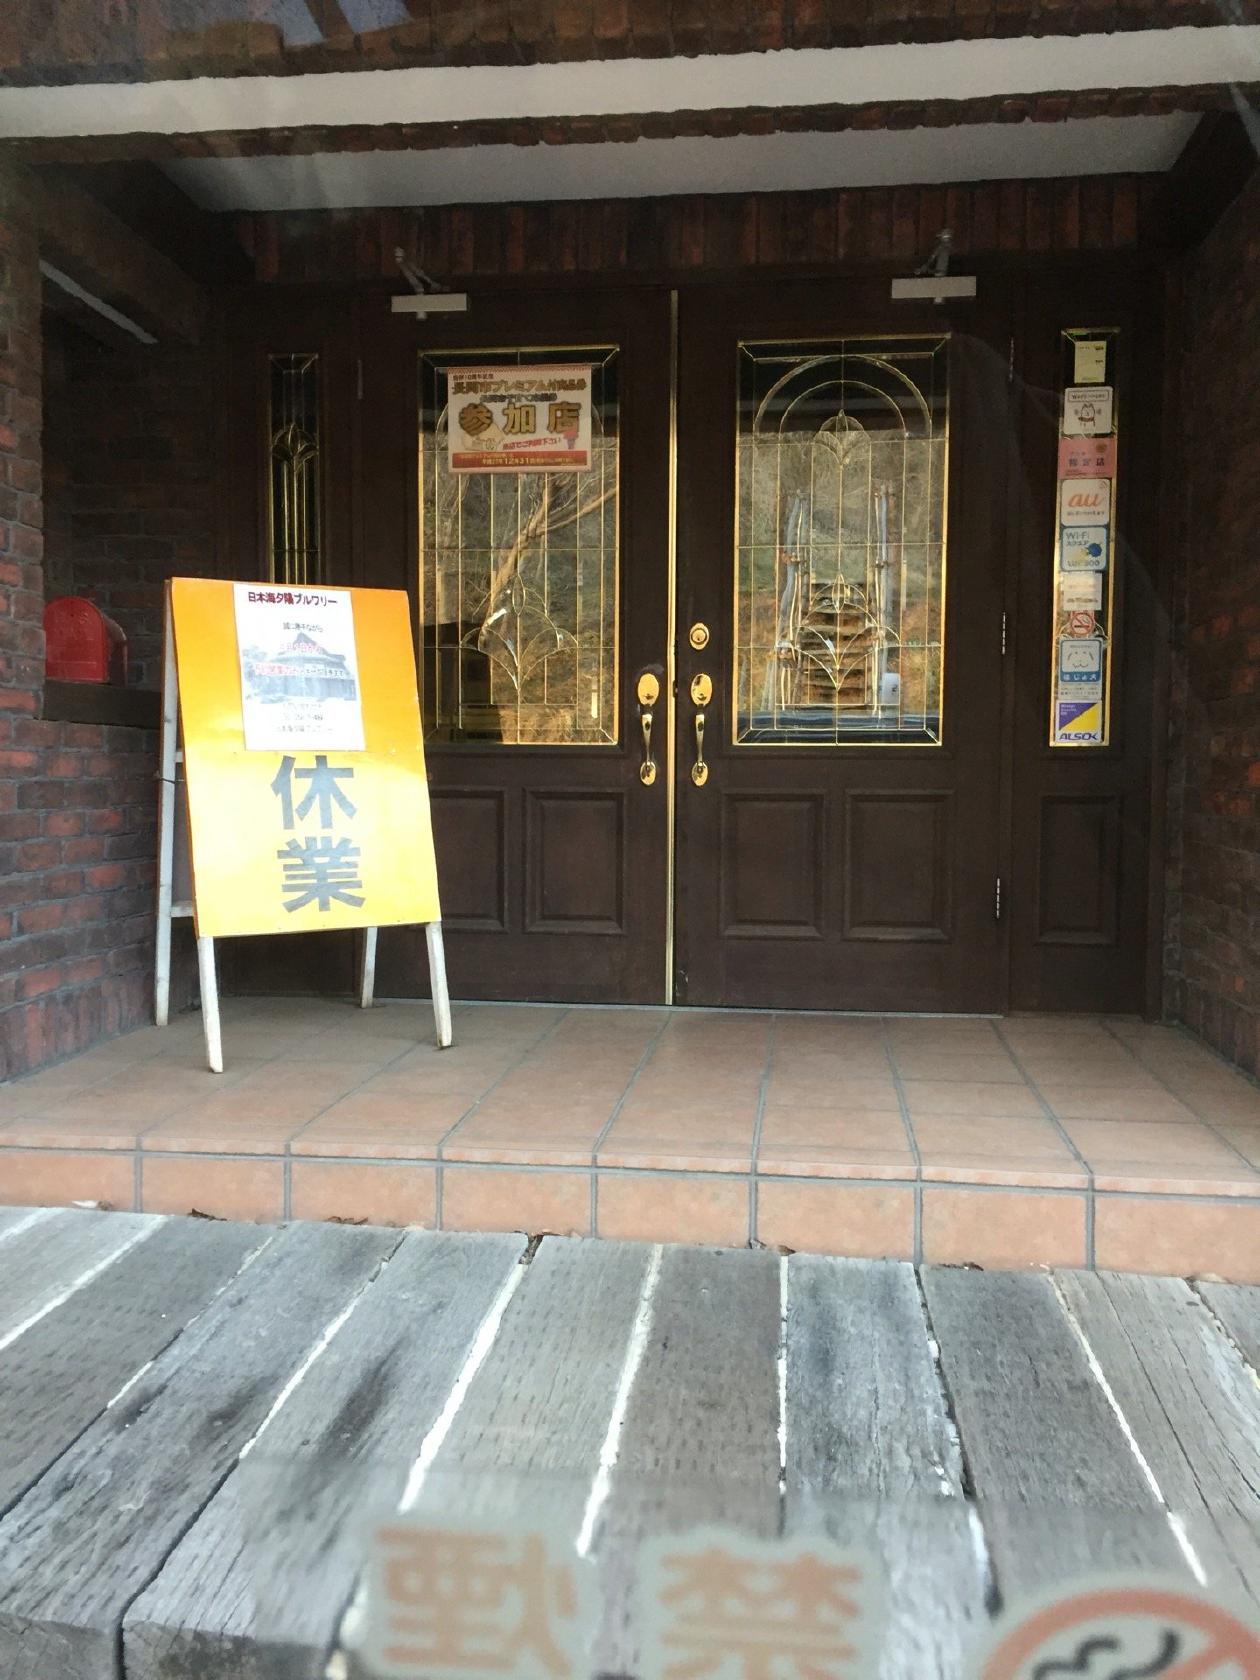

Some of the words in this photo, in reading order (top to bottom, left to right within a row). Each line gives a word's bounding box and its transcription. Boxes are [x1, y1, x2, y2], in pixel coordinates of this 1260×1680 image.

[458, 401, 582, 436] 参加店
[1068, 493, 1099, 508] au
[247, 591, 338, 607] 日本海夕陽ブルワリー
[1059, 732, 1098, 741] ALSOK
[270, 755, 367, 914] 休業
